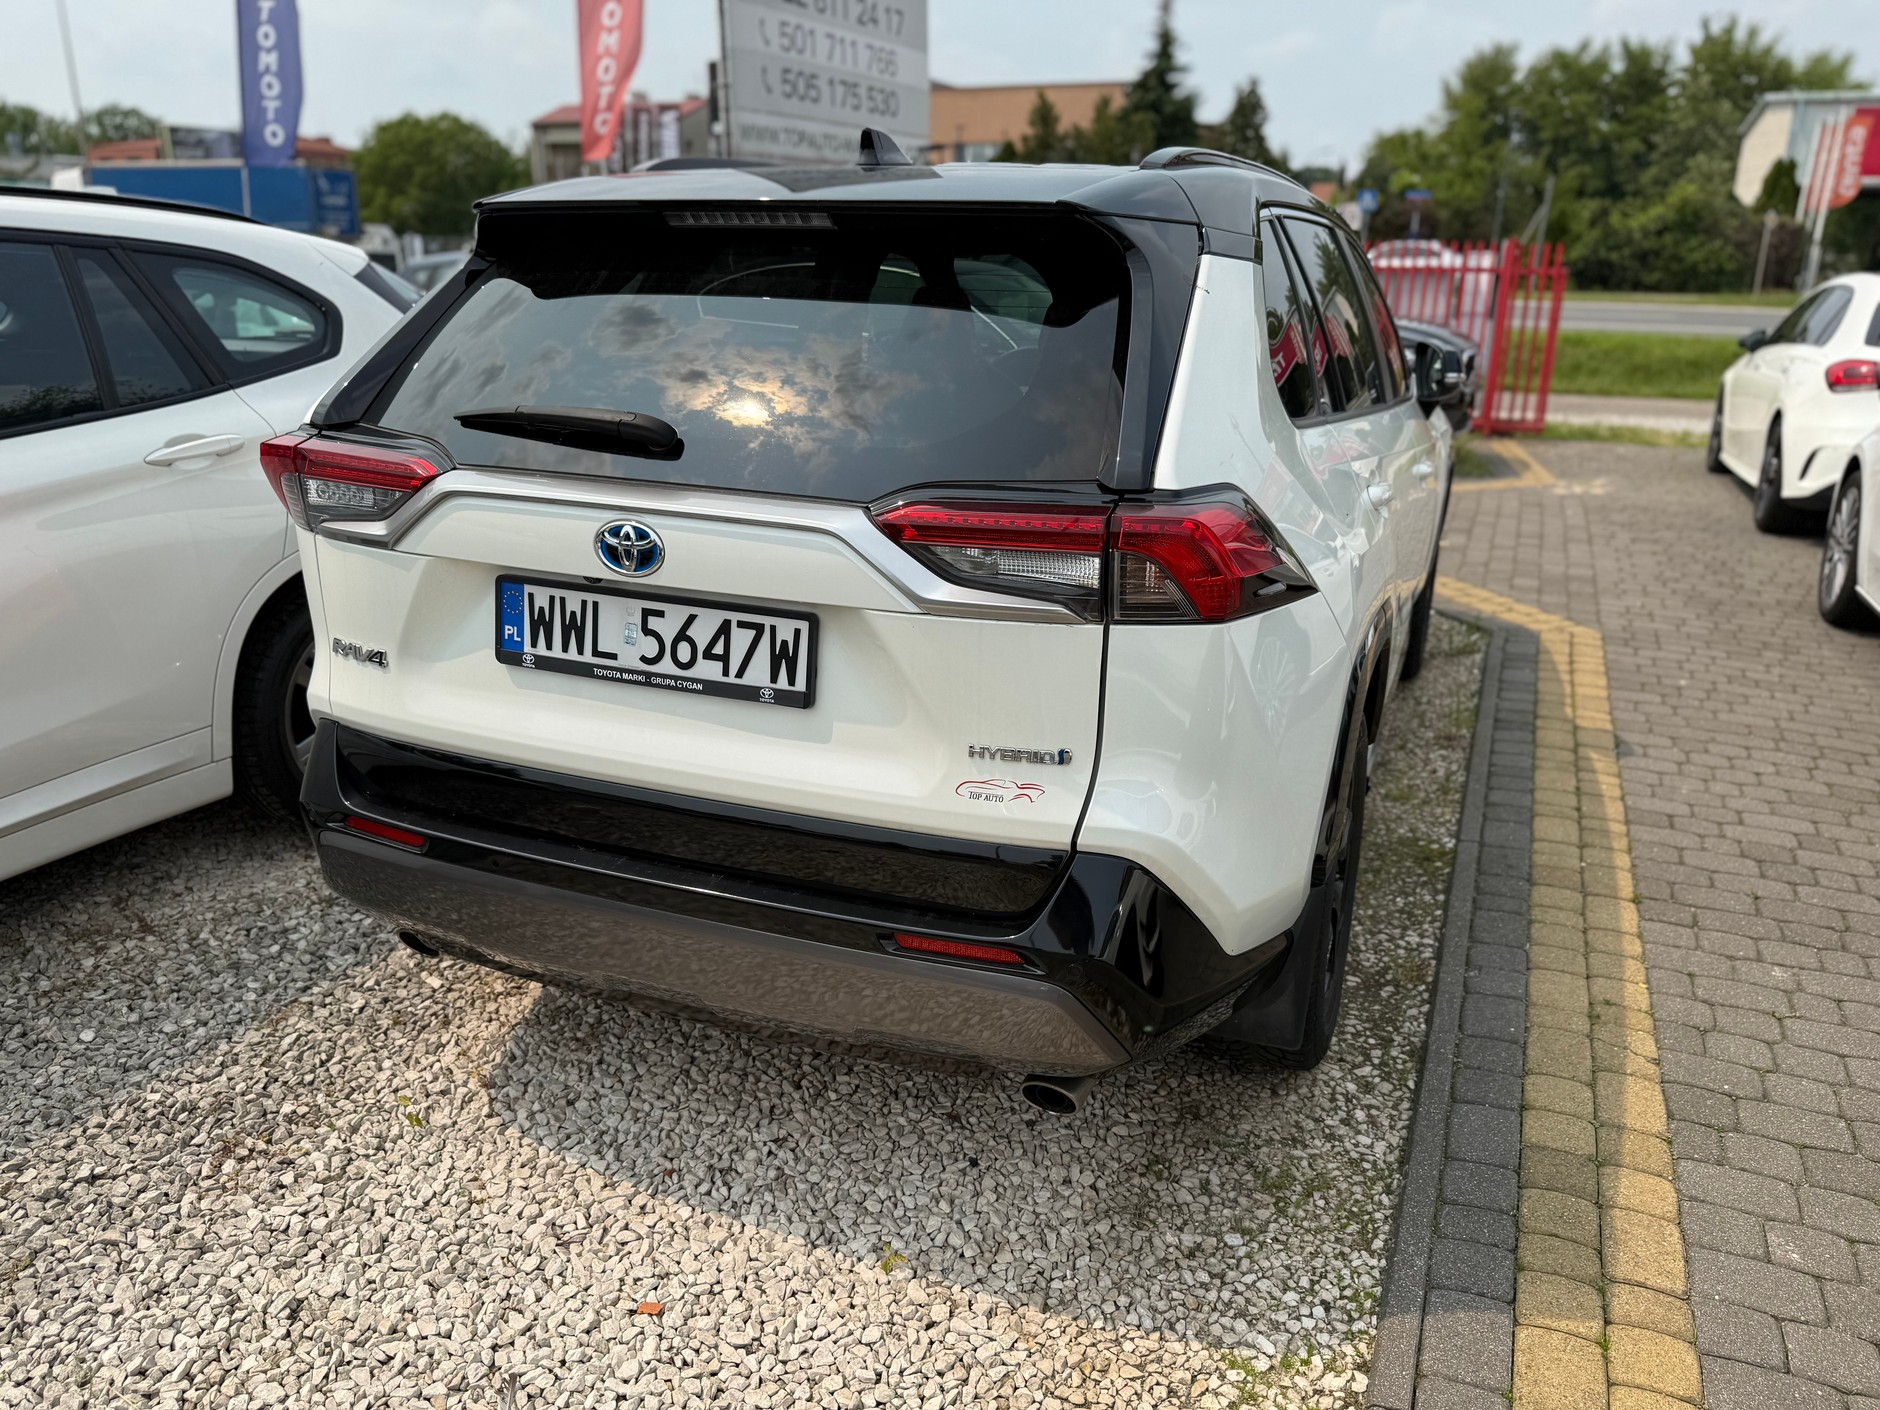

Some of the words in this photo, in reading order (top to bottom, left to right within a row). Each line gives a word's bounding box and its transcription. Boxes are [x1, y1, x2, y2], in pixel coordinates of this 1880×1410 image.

[856, 0, 879, 28] 24
[884, 6, 905, 37] 17
[779, 20, 817, 58] 501
[825, 32, 859, 67] 711
[256, 0, 286, 148] TOMOTO
[780, 67, 822, 104] 505
[828, 76, 863, 112] 175
[866, 85, 901, 118] 530
[505, 625, 522, 641] PL
[528, 592, 618, 661] WWL
[639, 607, 802, 687] 5647W
[332, 637, 389, 668] RAV4
[593, 668, 621, 679] TOYOTA
[622, 673, 646, 682] MARKI
[651, 677, 676, 686] GRUPA
[677, 680, 703, 691] CYGAN
[968, 743, 1056, 765] HYBRID
[968, 791, 983, 800] TOP
[984, 793, 1005, 803] AUTO
